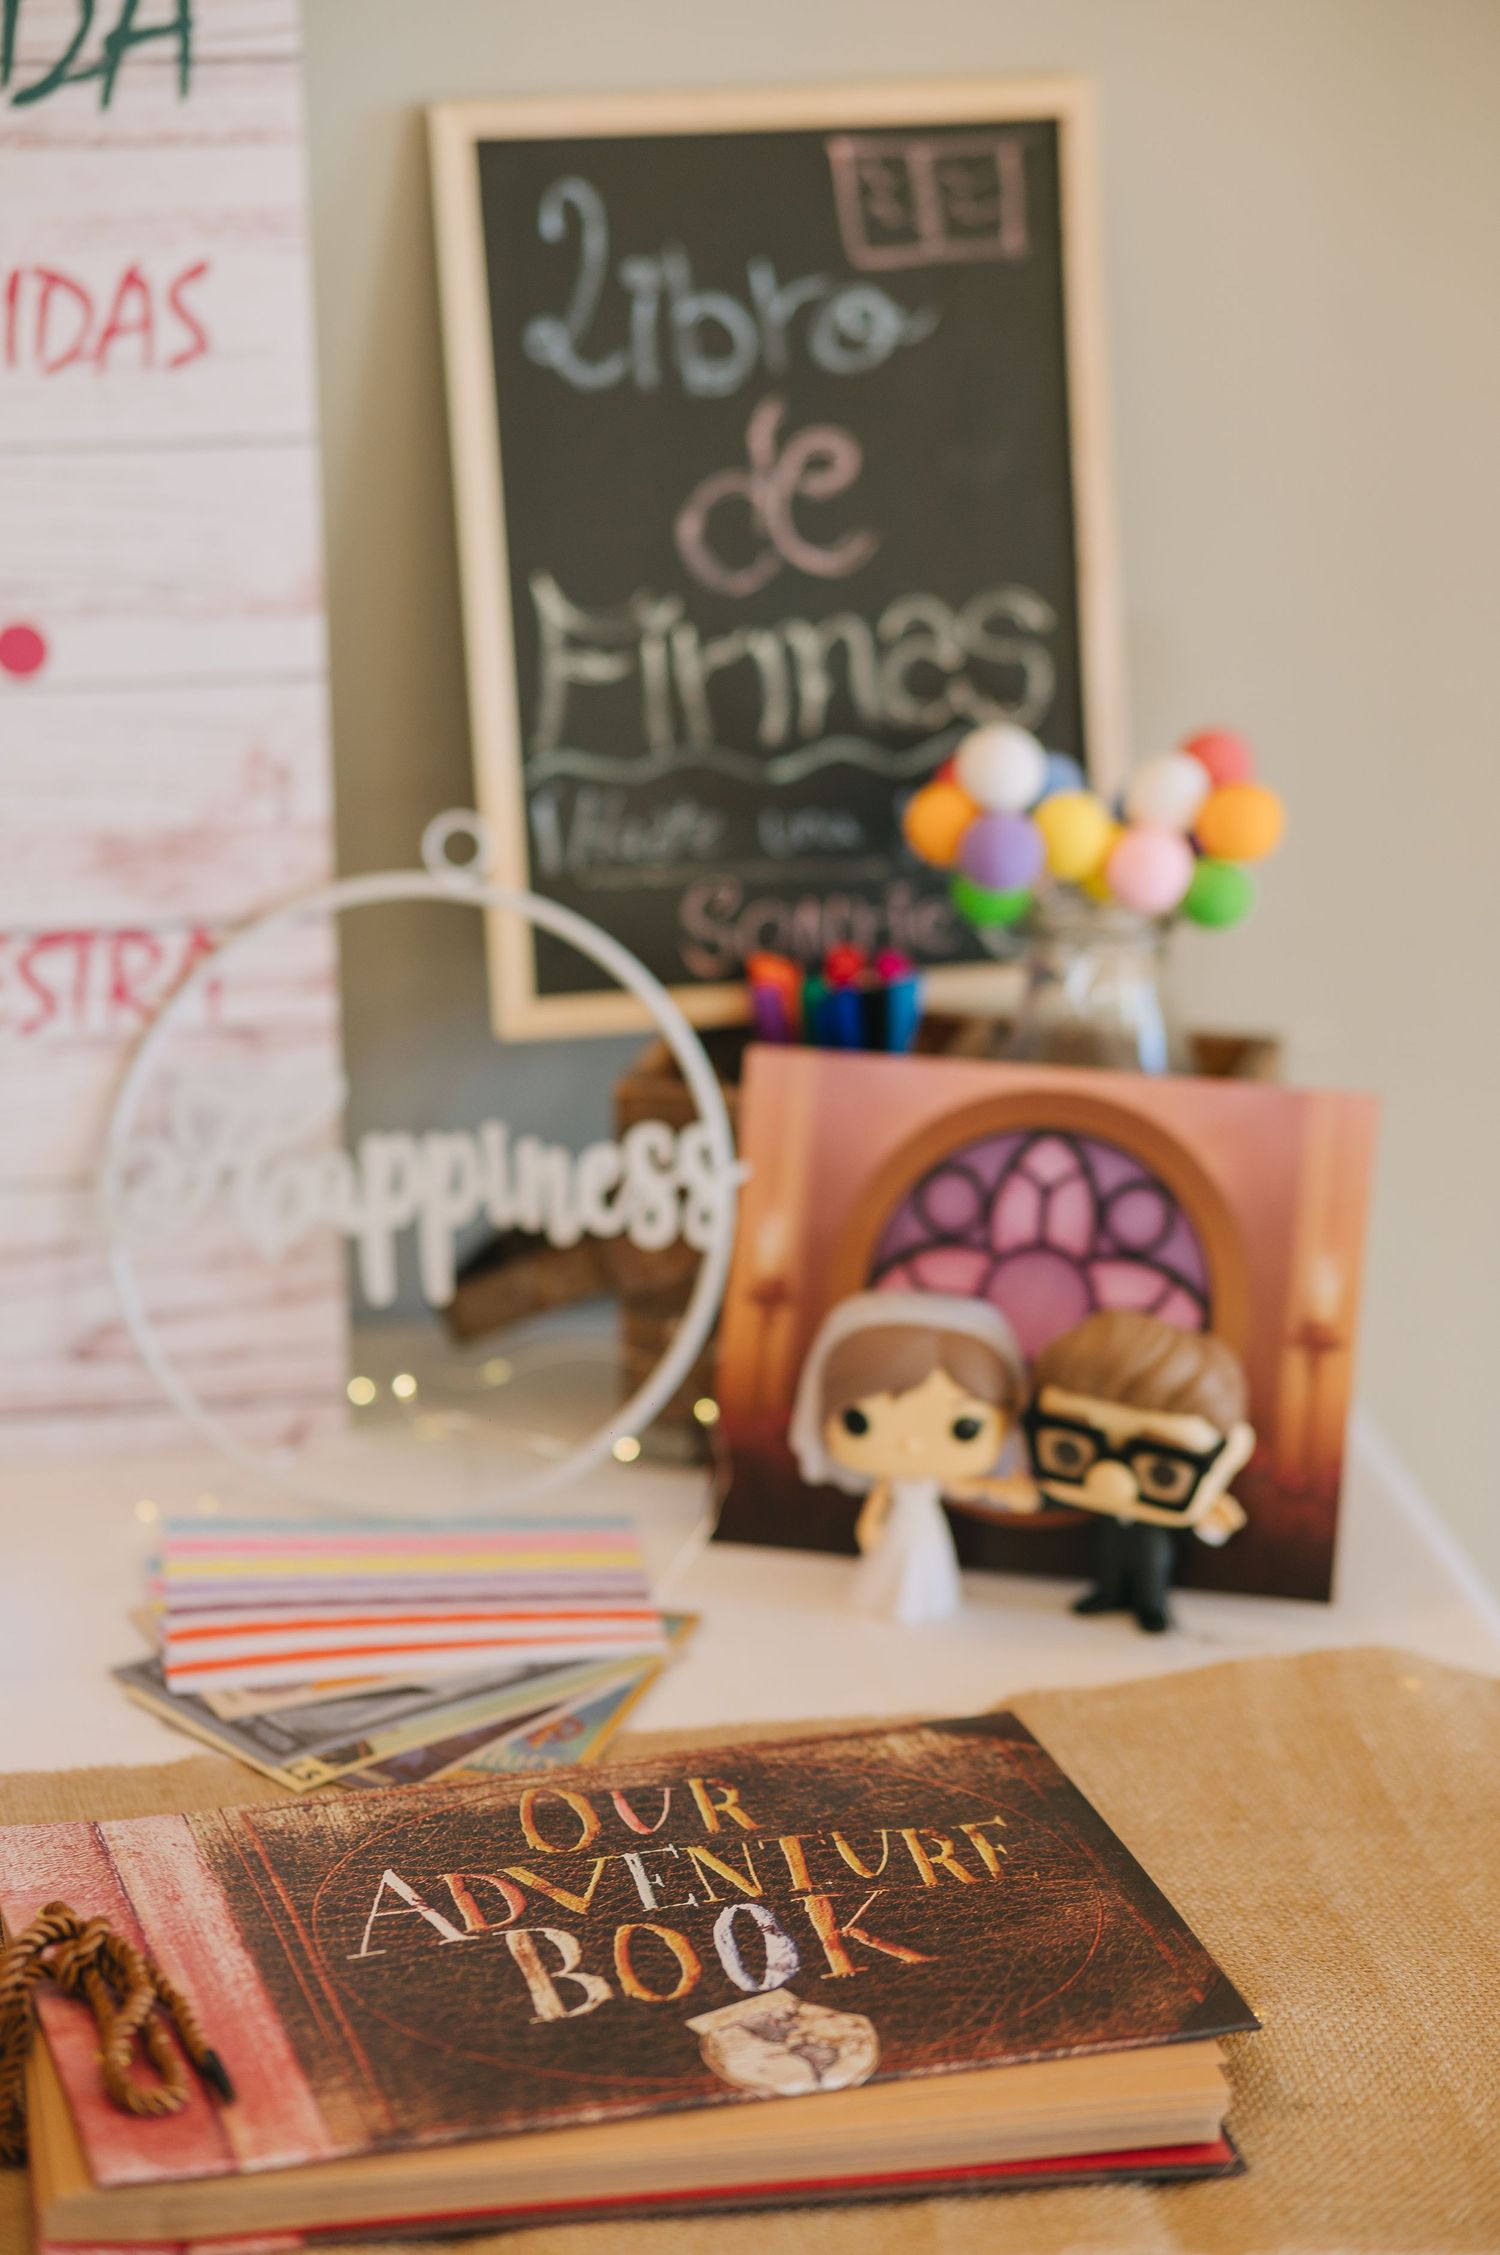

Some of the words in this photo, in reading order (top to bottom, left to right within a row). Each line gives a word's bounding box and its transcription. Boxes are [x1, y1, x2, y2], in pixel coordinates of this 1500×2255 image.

[522, 172, 942, 398] Libro
[674, 394, 882, 598] de
[530, 568, 1058, 758] Firmas
[347, 1816, 1030, 1960] ADVENTURE
[518, 1777, 766, 1853] OUR
[493, 1889, 938, 2024] BOOK
